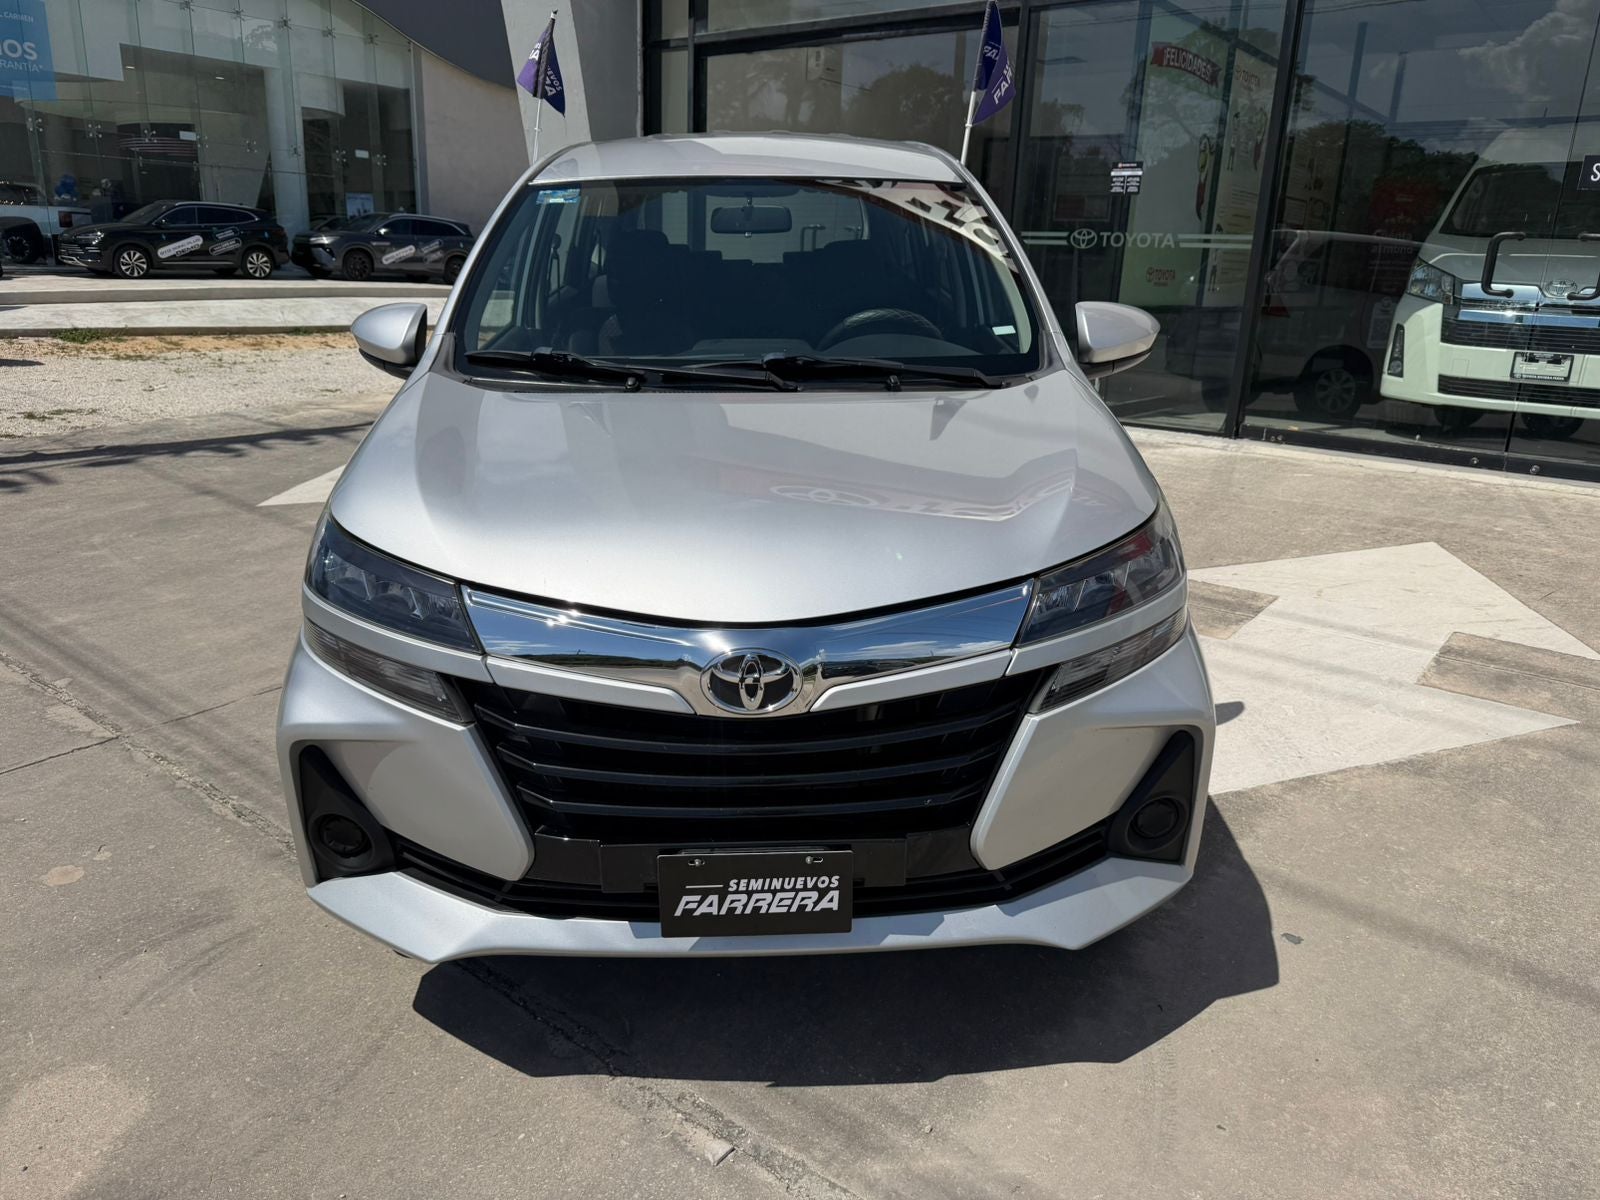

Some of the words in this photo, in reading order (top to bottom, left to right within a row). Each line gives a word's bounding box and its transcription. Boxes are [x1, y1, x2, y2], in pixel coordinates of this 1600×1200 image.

[0, 38, 38, 61] OS
[1099, 231, 1175, 249] TOYOTA
[176, 243, 200, 256] DEMO
[727, 875, 841, 892] SEMINUEVOS
[673, 890, 841, 917] FARRERA
